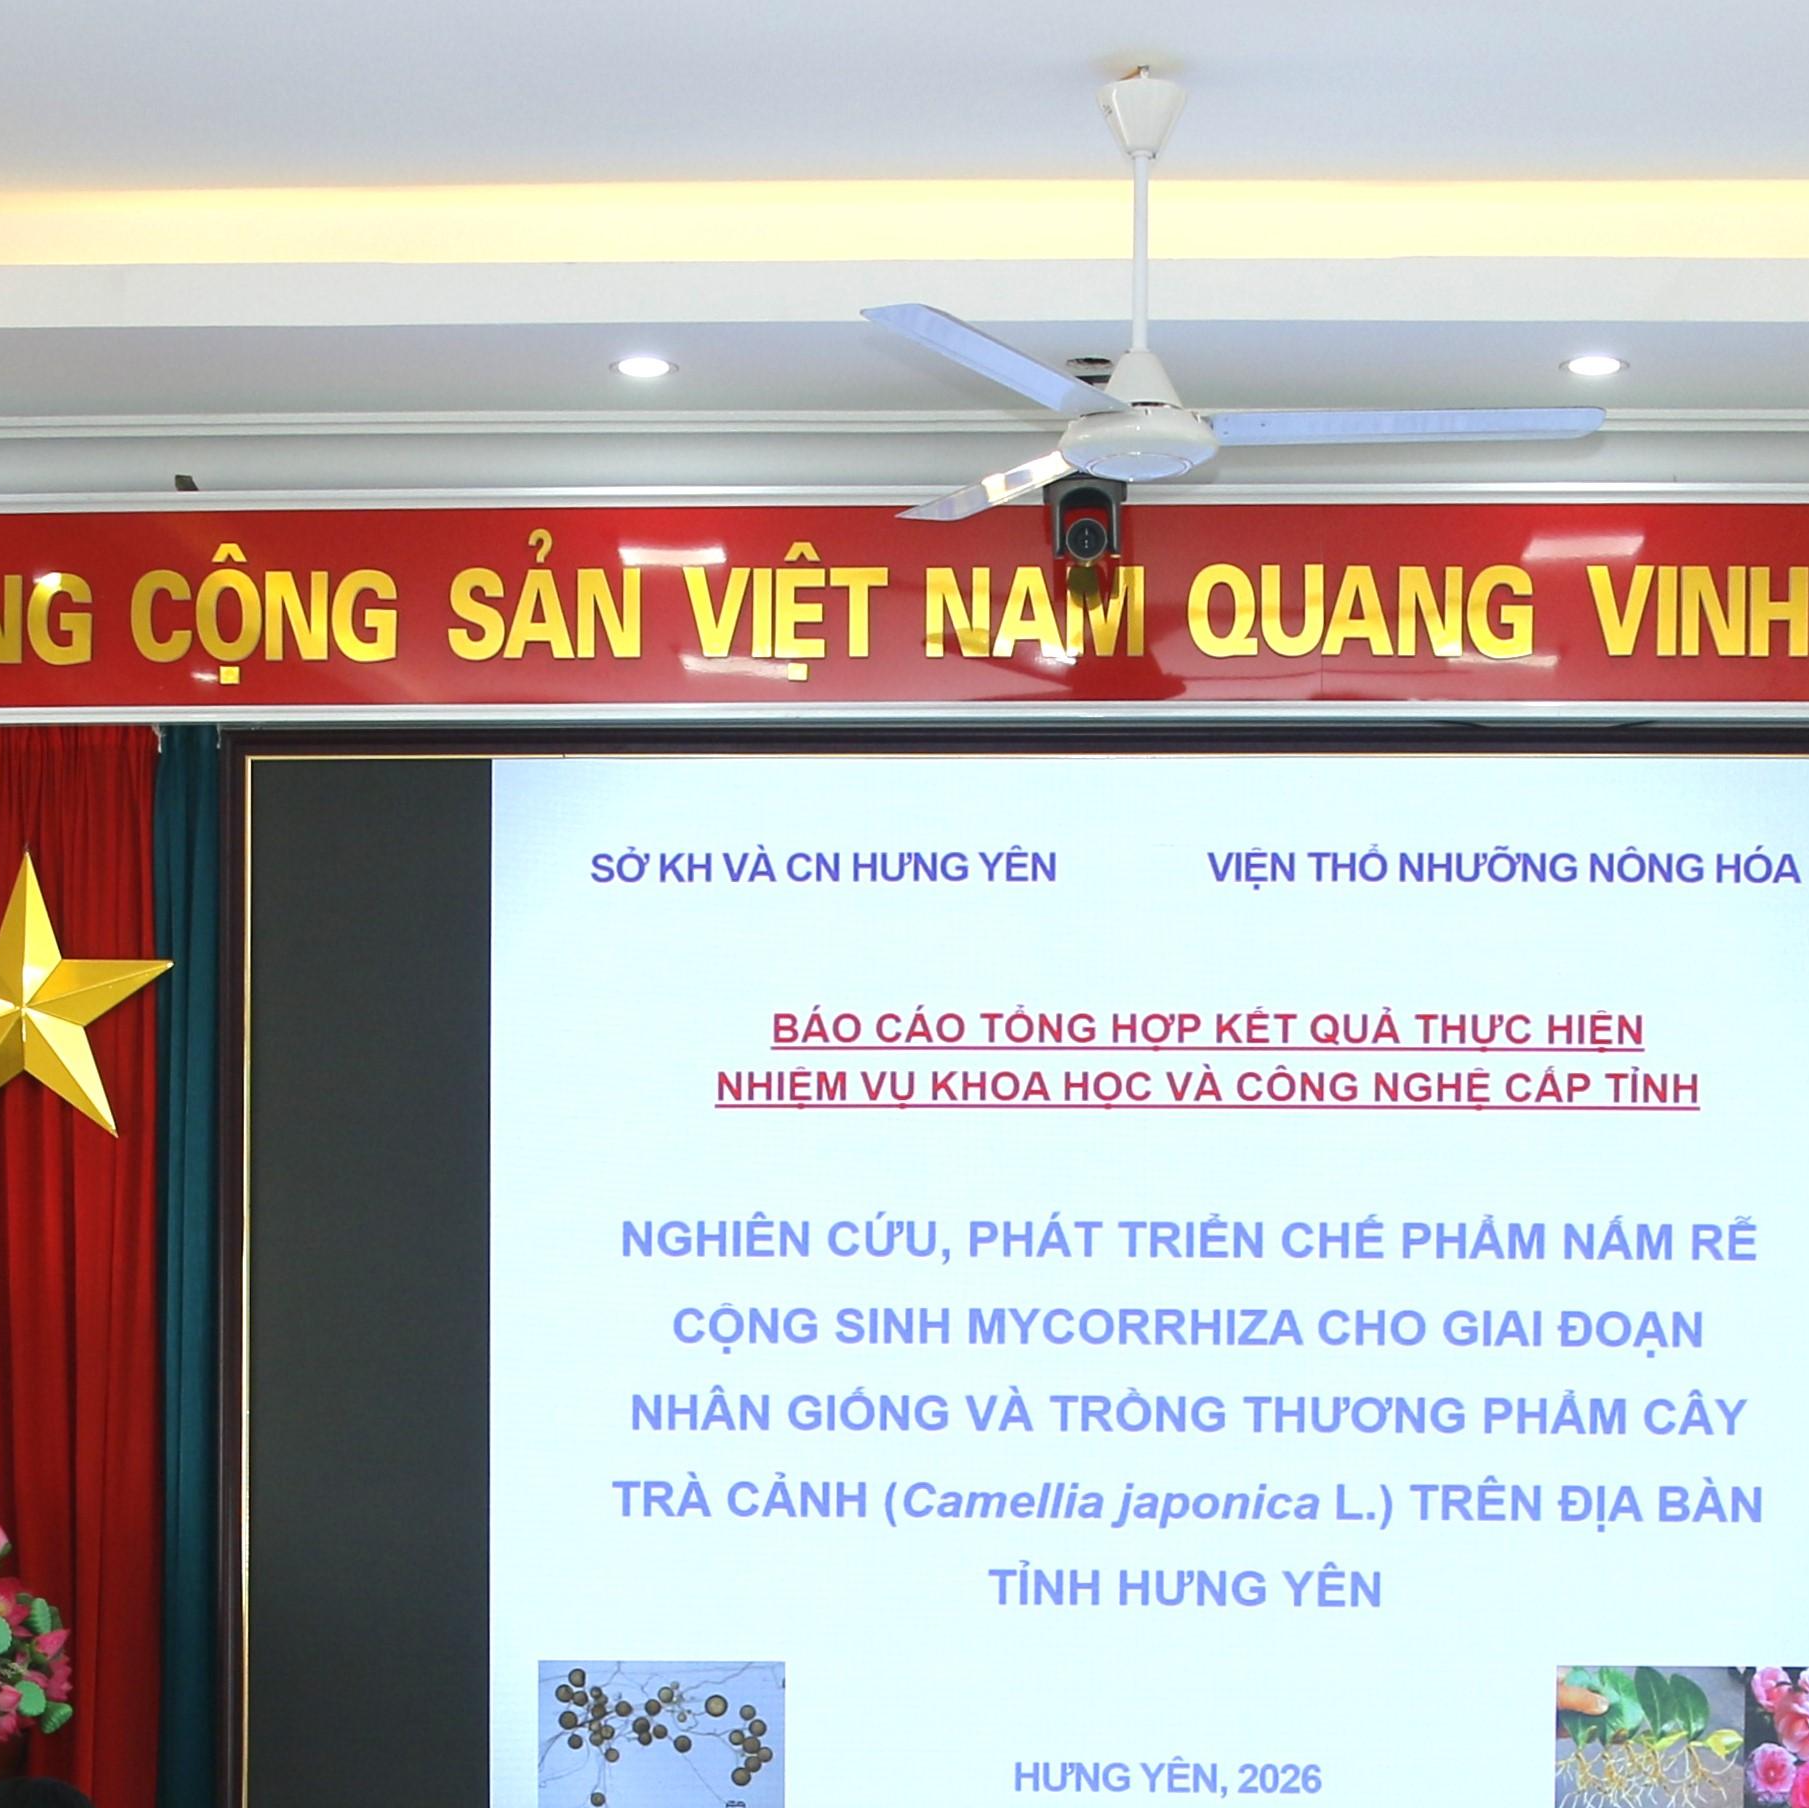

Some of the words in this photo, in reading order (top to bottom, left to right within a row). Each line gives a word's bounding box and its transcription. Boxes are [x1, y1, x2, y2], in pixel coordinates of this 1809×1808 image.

[131, 543, 398, 684] CỘNG
[447, 528, 642, 660] SẢN
[682, 541, 889, 682] VIỆT
[924, 565, 1145, 659] NAM
[1188, 562, 1535, 660] QUANG
[1585, 565, 1809, 658] VINH
[590, 845, 650, 883] SỞ
[659, 851, 713, 884] KH
[722, 843, 778, 883] VÀ
[785, 851, 841, 883] CN
[852, 850, 970, 883] HƯNG
[977, 843, 1057, 883] YÊN
[1206, 846, 1296, 891] VIỆN
[1306, 842, 1389, 883] THỔ
[1398, 844, 1579, 883] NHƯỠNG
[1589, 844, 1705, 884] NÔNG
[1715, 844, 1803, 884] HÓA
[773, 1004, 862, 1044] BÁO
[875, 1004, 965, 1044] CÁO
[980, 1003, 1097, 1044] TỔNG
[1112, 1012, 1201, 1051] HỢP
[1215, 1005, 1298, 1045] KẾT
[1309, 1006, 1401, 1046] QUẢ
[1414, 1013, 1532, 1052] THỰC
[1547, 1009, 1644, 1053] HIỆN
[717, 1066, 847, 1109] NHIỆM
[860, 1070, 915, 1109] VỤ
[931, 1070, 1052, 1102] KHOA
[1063, 1070, 1152, 1109] HỌC
[1165, 1063, 1223, 1102] VÀ
[1236, 1064, 1358, 1103] CÔNG
[1373, 1067, 1491, 1110] NGHỆ
[1505, 1065, 1591, 1104] CẤP
[1604, 1066, 1699, 1105] TỈNH
[621, 1210, 811, 1258] NGHIÊN
[826, 1210, 951, 1265] CỨU,
[968, 1210, 1104, 1258] PHÁT
[1117, 1212, 1264, 1259] TRIỂN
[1281, 1213, 1385, 1260] CHẾ
[1401, 1213, 1547, 1260] PHẨM
[1563, 1215, 1674, 1261] NẤM
[1691, 1215, 1758, 1262] RỄ
[672, 1301, 819, 1355] CỘNG
[834, 1306, 951, 1345] SINH
[967, 1307, 1304, 1346] MYCORRHIZA
[1317, 1308, 1427, 1347] CHO
[1442, 1309, 1543, 1348] GIAI
[1556, 1309, 1703, 1358] ĐOẠN
[631, 1384, 771, 1432] NHÂN
[787, 1385, 950, 1432] GIỐNG
[964, 1384, 1035, 1432] VÀ
[1048, 1386, 1227, 1433] TRỒNG
[1242, 1395, 1466, 1434] THƯƠNG
[1483, 1388, 1628, 1436] PHẨM
[1643, 1388, 1749, 1436] CÂY
[612, 1470, 712, 1518] TRÀ
[726, 1471, 868, 1519] CẢNH
[884, 1481, 1104, 1528] (Camellia
[1110, 1483, 1320, 1529] japonica
[1335, 1483, 1394, 1531] L.)
[1408, 1474, 1543, 1522] TRÊN
[1556, 1484, 1645, 1533] ĐỊA
[1658, 1475, 1763, 1524] BÀN
[987, 1559, 1101, 1607] TỈNH
[1118, 1568, 1267, 1607] HƯNG
[1281, 1560, 1382, 1608] YÊN
[1014, 1761, 1132, 1793] HƯNG
[1140, 1755, 1229, 1799] YÊN,
[1237, 1762, 1323, 1795] 2026
